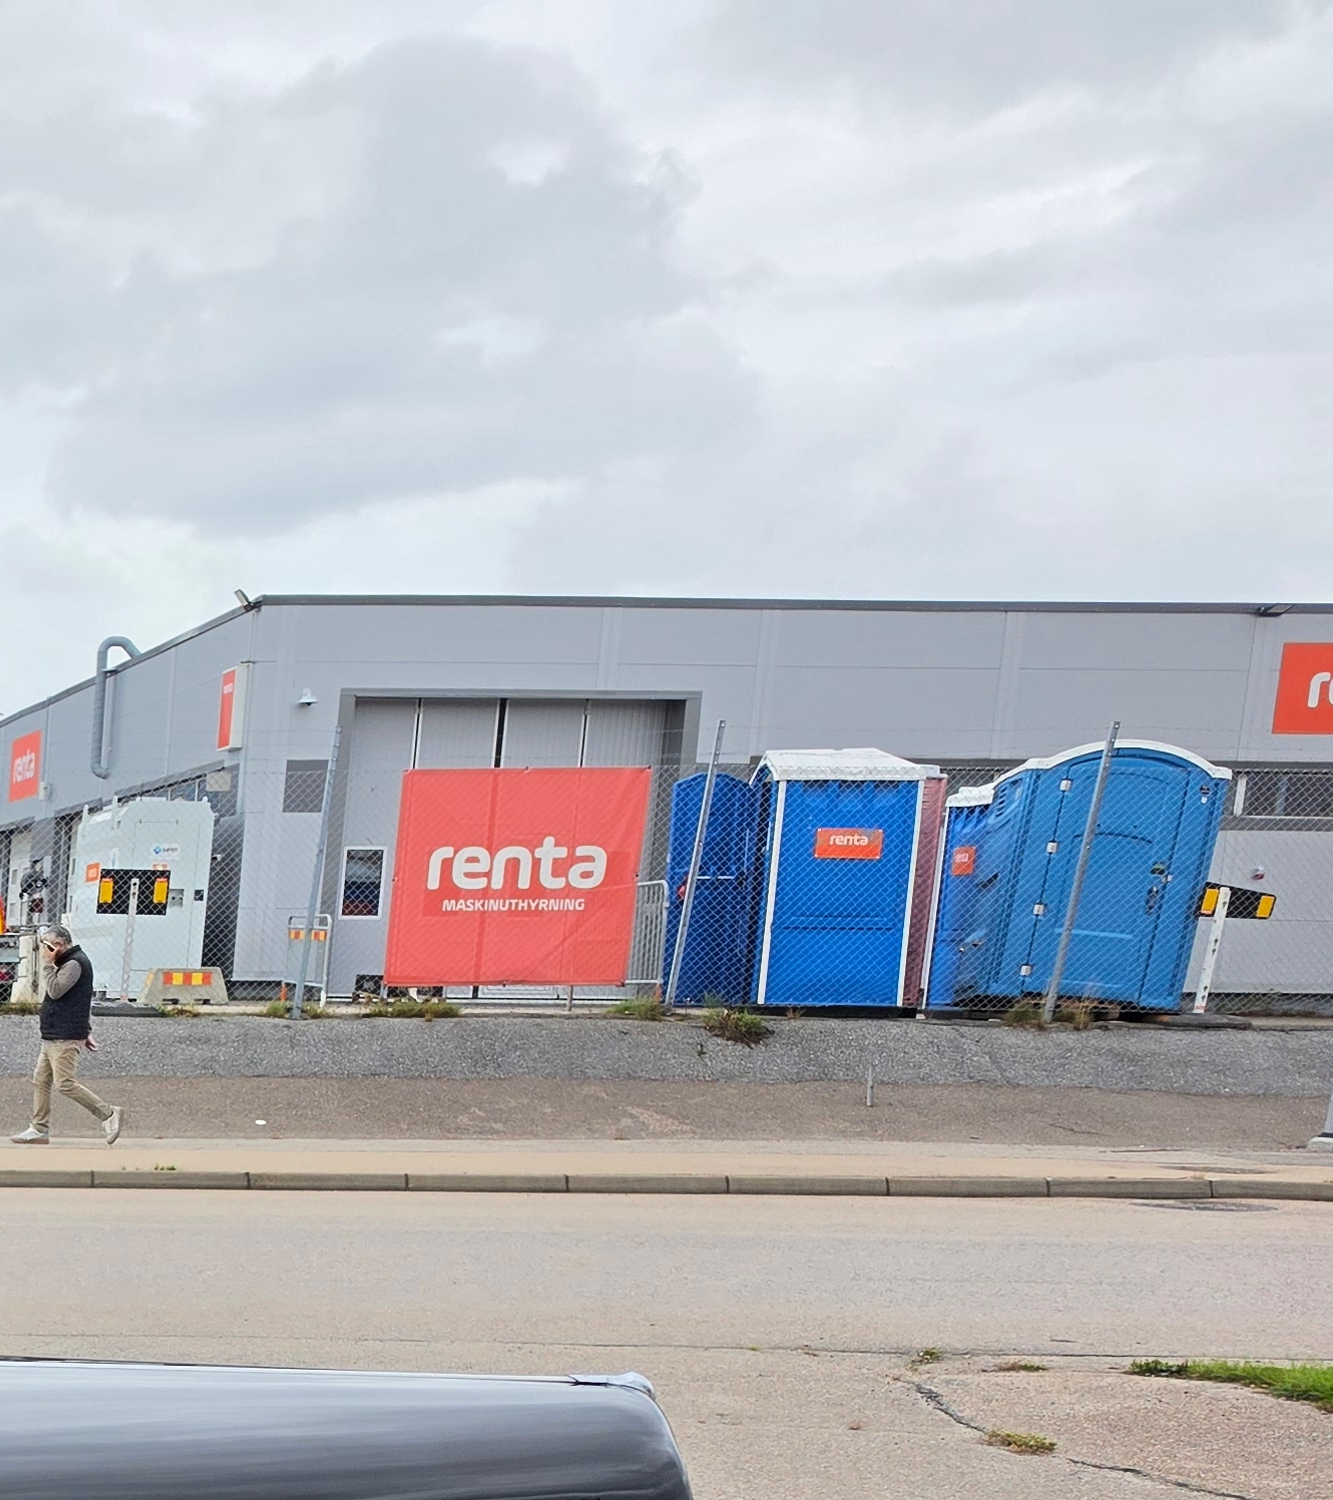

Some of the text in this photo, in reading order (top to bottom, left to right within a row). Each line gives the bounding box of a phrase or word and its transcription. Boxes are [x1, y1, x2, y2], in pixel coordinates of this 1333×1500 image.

[1307, 671, 1333, 708] r
[829, 833, 869, 846] renta
[427, 836, 607, 890] renta
[442, 898, 585, 912] MASKINUTHYRNING
